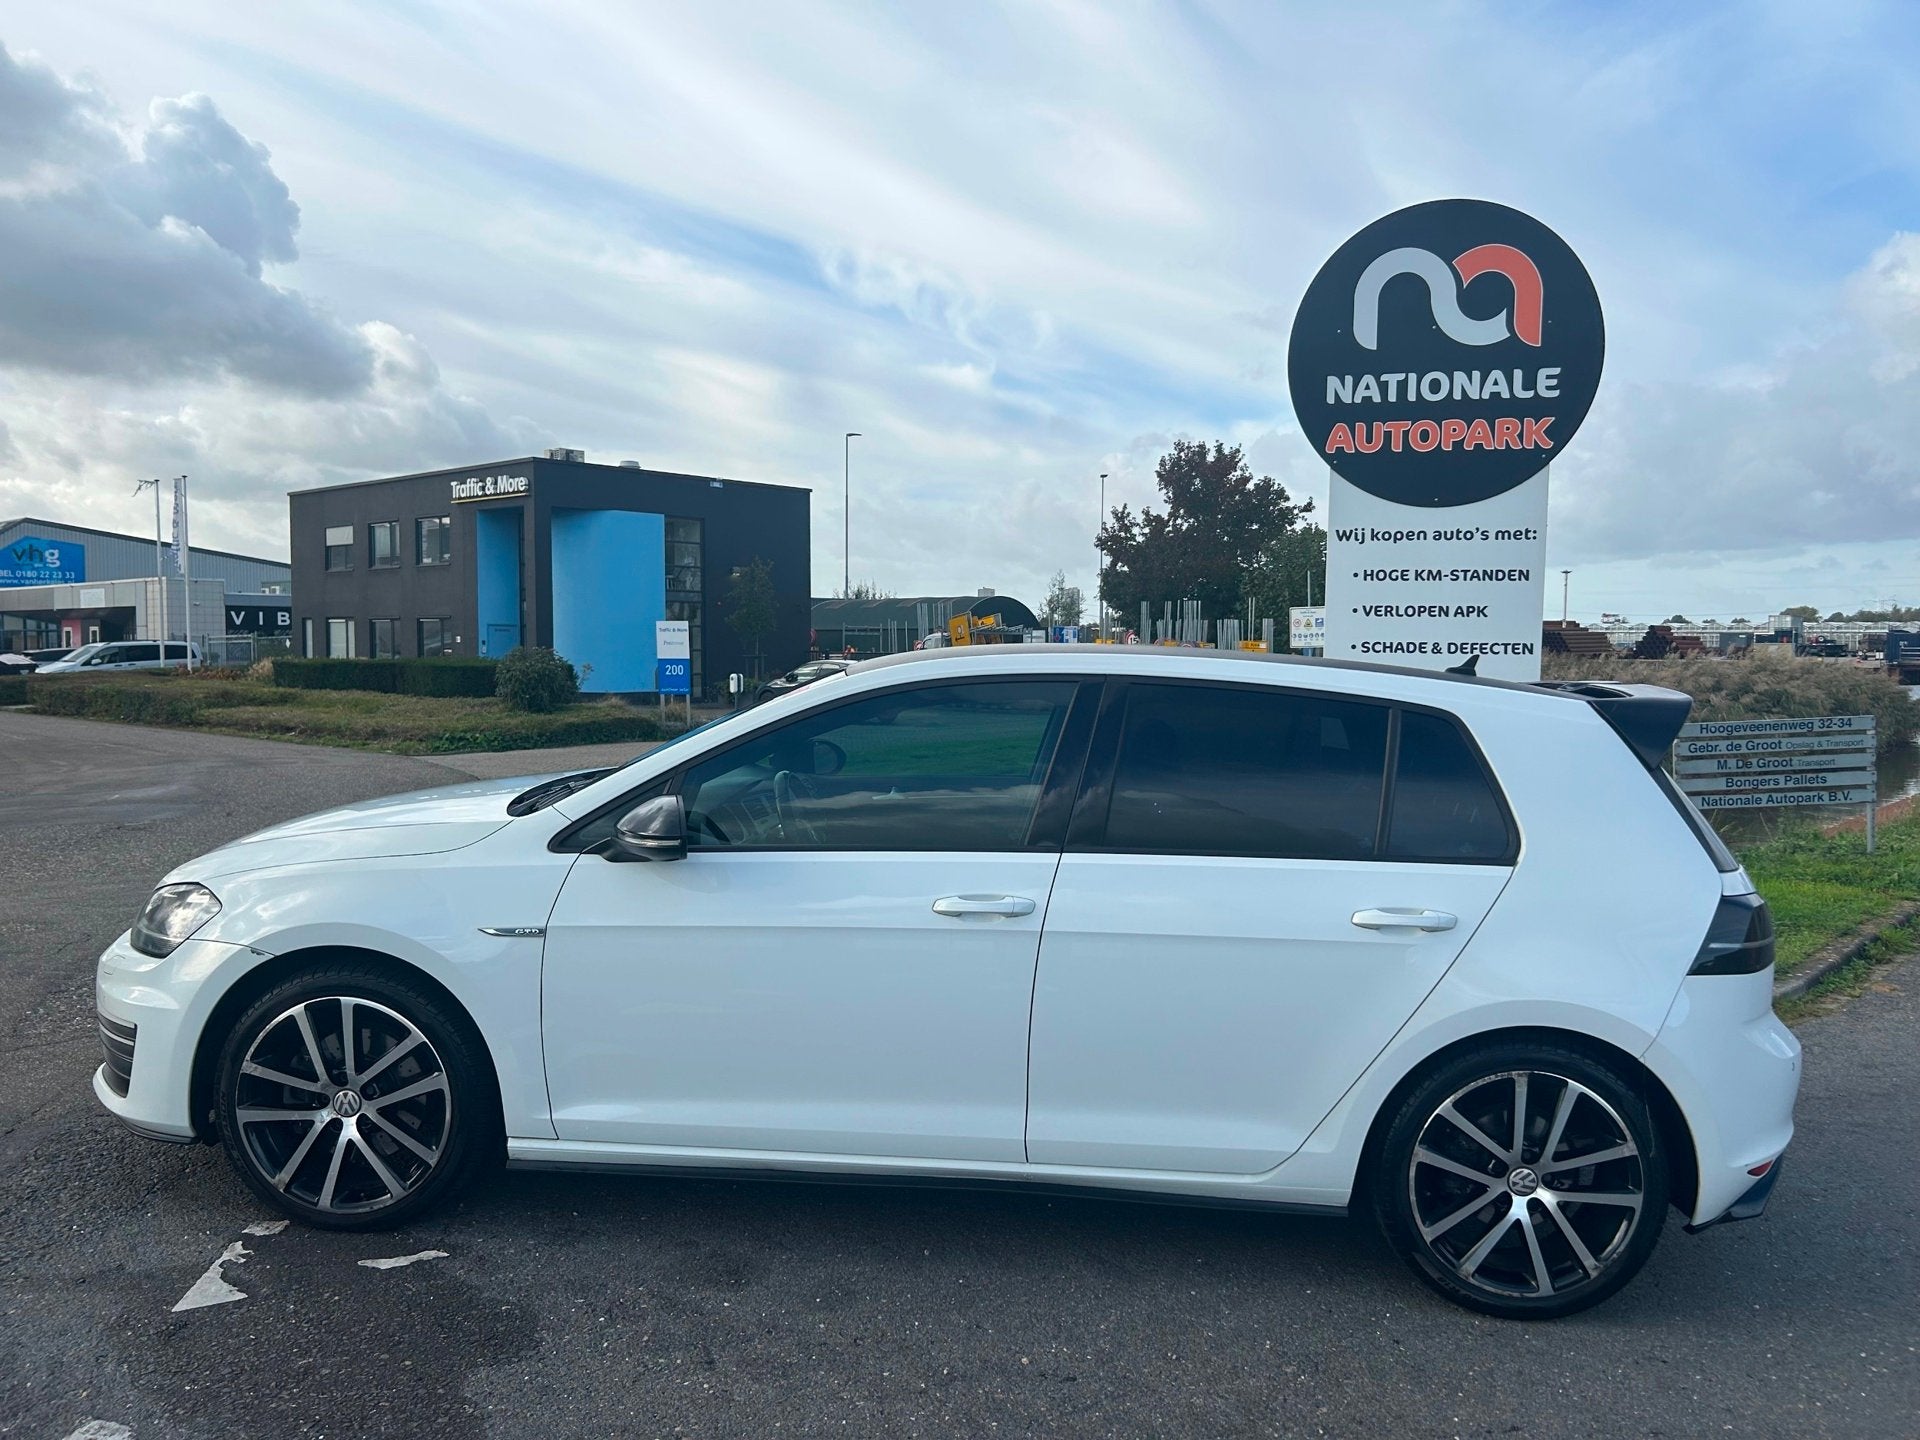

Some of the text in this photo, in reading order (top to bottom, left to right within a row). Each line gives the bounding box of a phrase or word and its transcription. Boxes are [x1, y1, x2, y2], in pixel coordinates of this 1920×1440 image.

[1326, 367, 1561, 404] NATIONALE
[1325, 417, 1555, 454] AUTOPARK
[450, 475, 528, 498] Traffic & More
[1335, 527, 1538, 544] Wij kopen auto's met:
[12, 544, 61, 568] vhg
[15, 570, 37, 578] 0180
[40, 570, 50, 578] 22
[1363, 569, 1530, 582] HOGE KM-STANDEN
[1362, 605, 1489, 618] VERLOPEN APK
[1360, 641, 1534, 655] SCHADE & DEFECTEN
[665, 664, 684, 675] 200
[1700, 718, 1852, 736] Hoogeveenenweg 32-34
[1688, 738, 1864, 754] Gebr. de Groot Opslag & Transport
[1717, 758, 1836, 770] M. De Groot Transport
[1725, 775, 1828, 790] Bongers Pallets
[1701, 790, 1853, 807] Nationale Autopark B.V.
